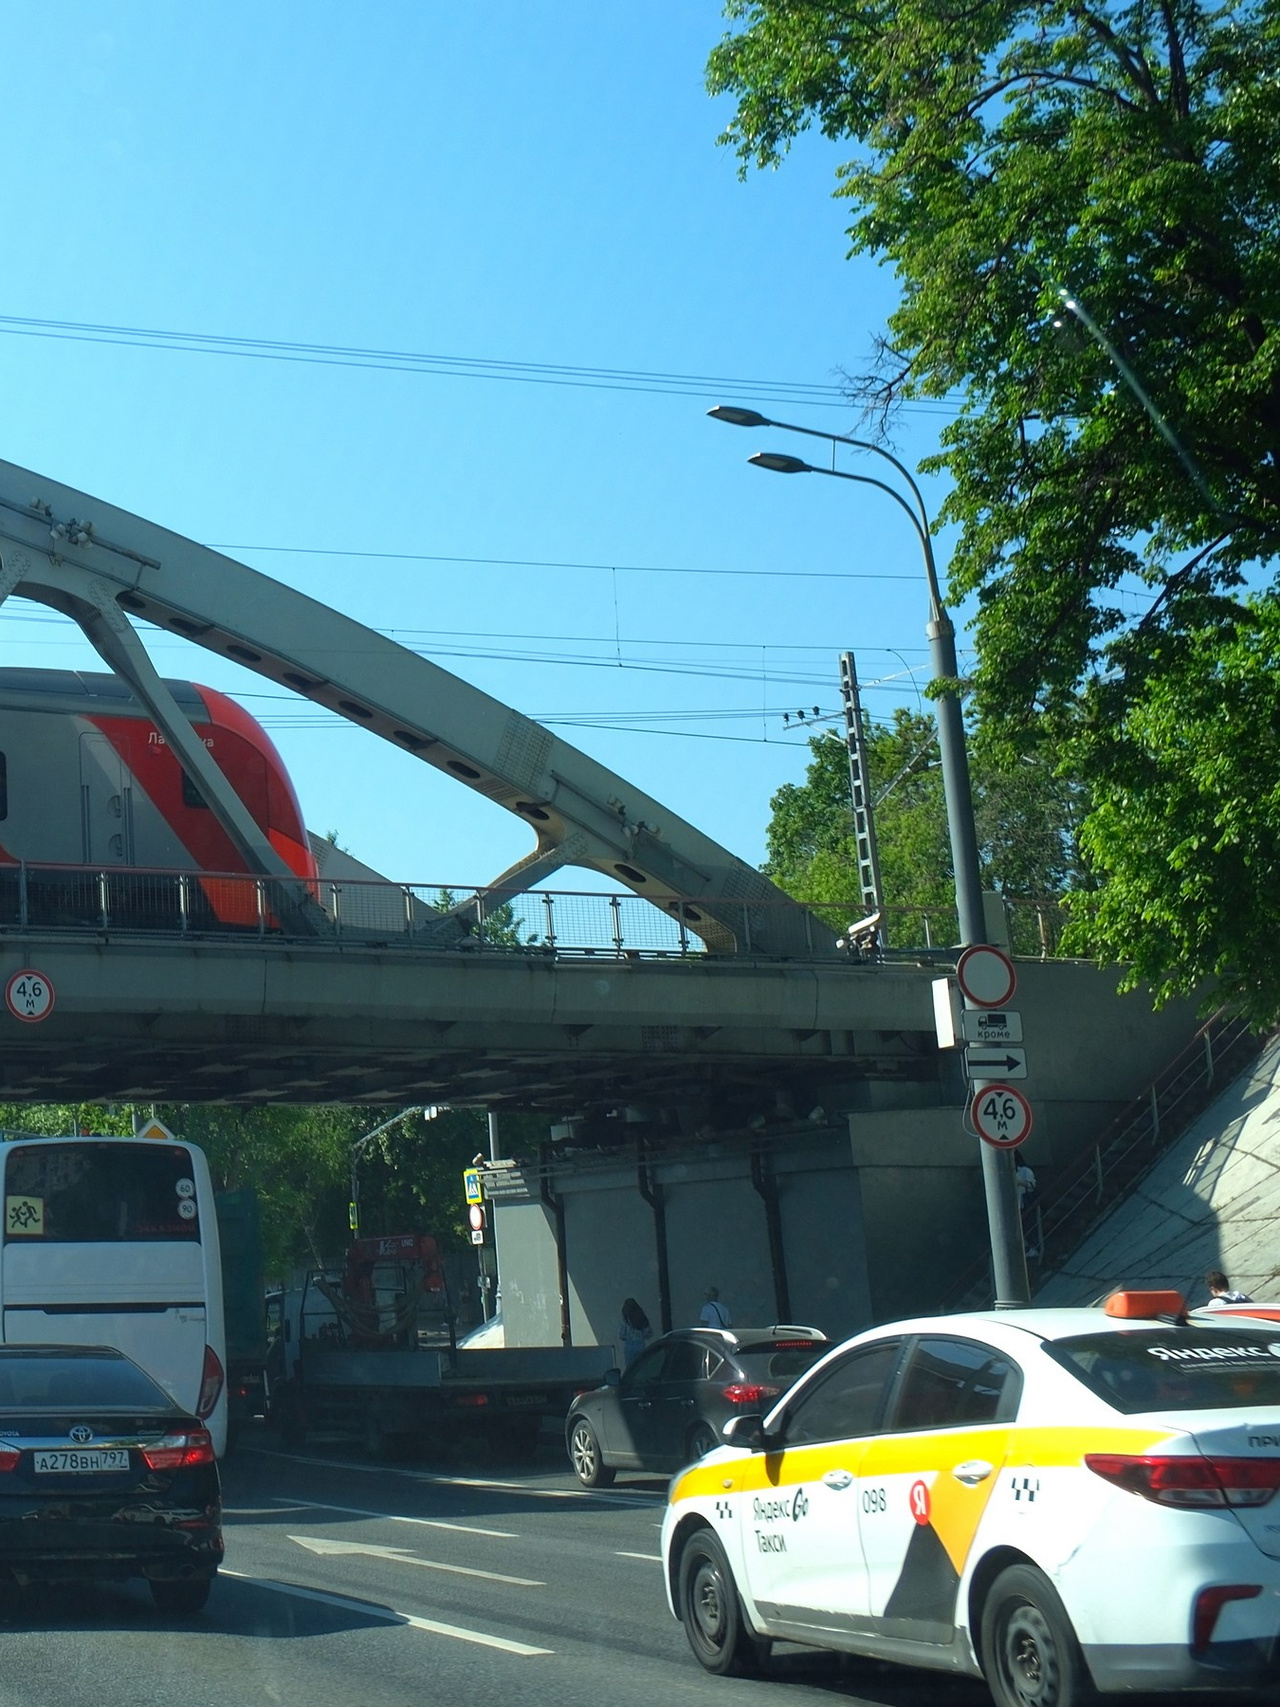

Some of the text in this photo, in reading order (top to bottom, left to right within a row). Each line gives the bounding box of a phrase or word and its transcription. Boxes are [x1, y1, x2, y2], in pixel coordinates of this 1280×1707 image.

[977, 1030, 1011, 1039] кроме
[983, 1098, 1016, 1121] 4,6
[180, 1184, 191, 1193] 60
[182, 1204, 193, 1213] 90
[1147, 1347, 1272, 1360] Яндекс
[753, 1487, 809, 1523] Яндекс Go
[862, 1488, 887, 1513] 098
[754, 1530, 787, 1553] Такси
